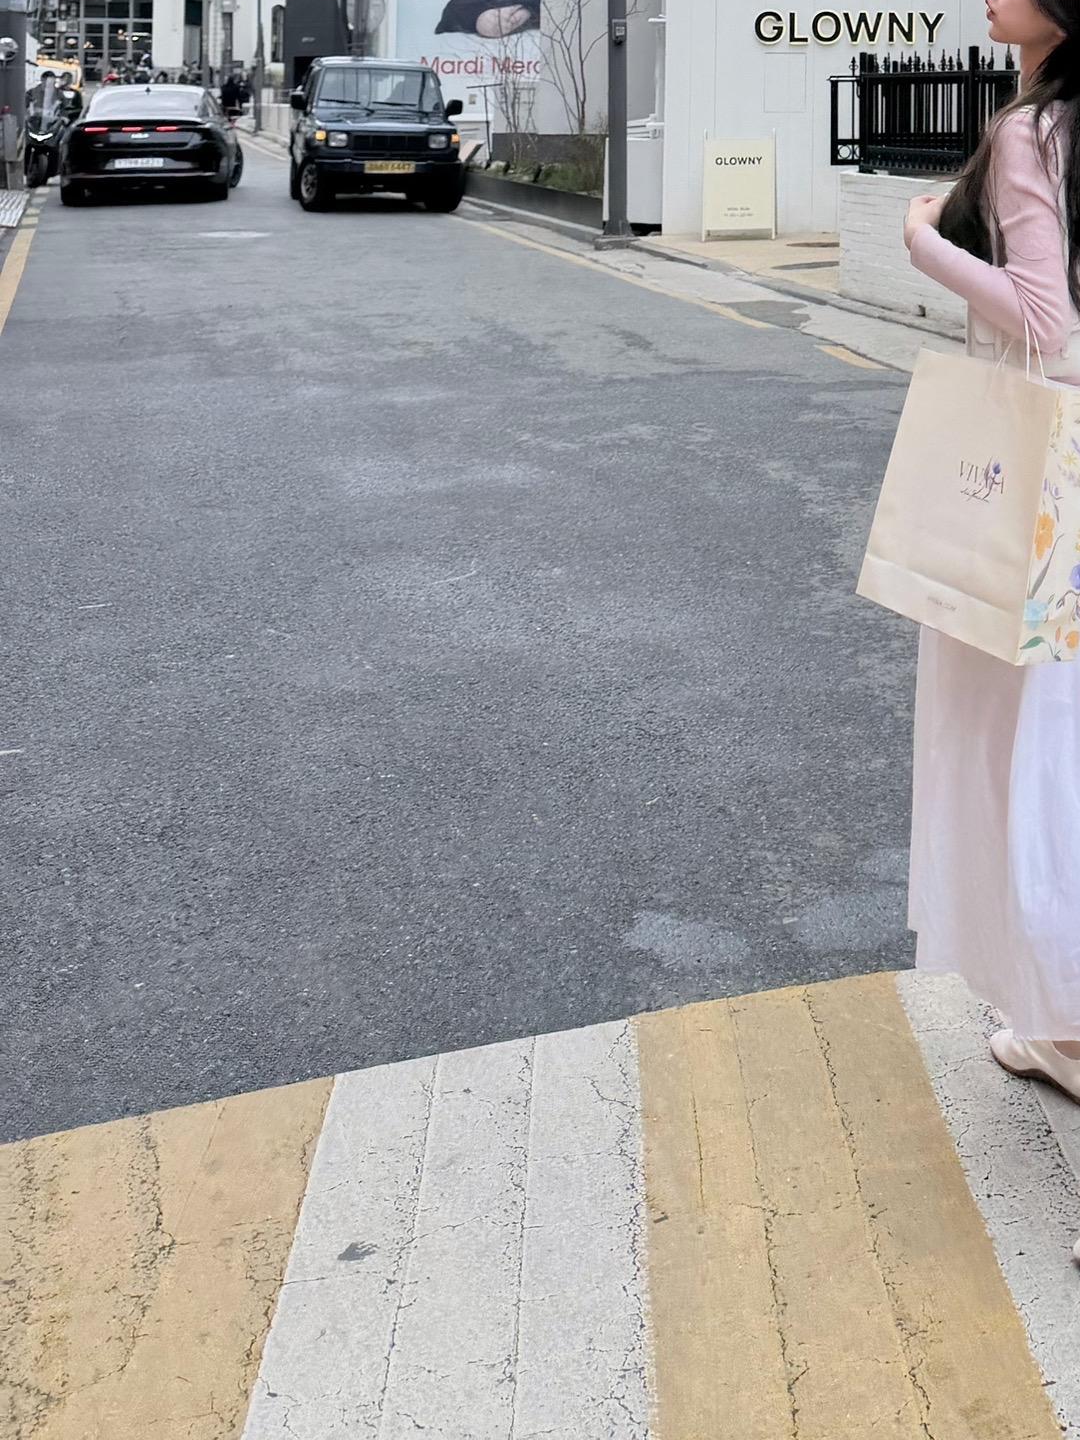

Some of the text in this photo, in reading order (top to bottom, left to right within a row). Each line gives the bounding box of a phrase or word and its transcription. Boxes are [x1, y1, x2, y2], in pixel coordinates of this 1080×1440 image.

[754, 10, 945, 44] GLOWNY
[420, 55, 484, 74] Mardi
[715, 156, 763, 165] GLOWNY
